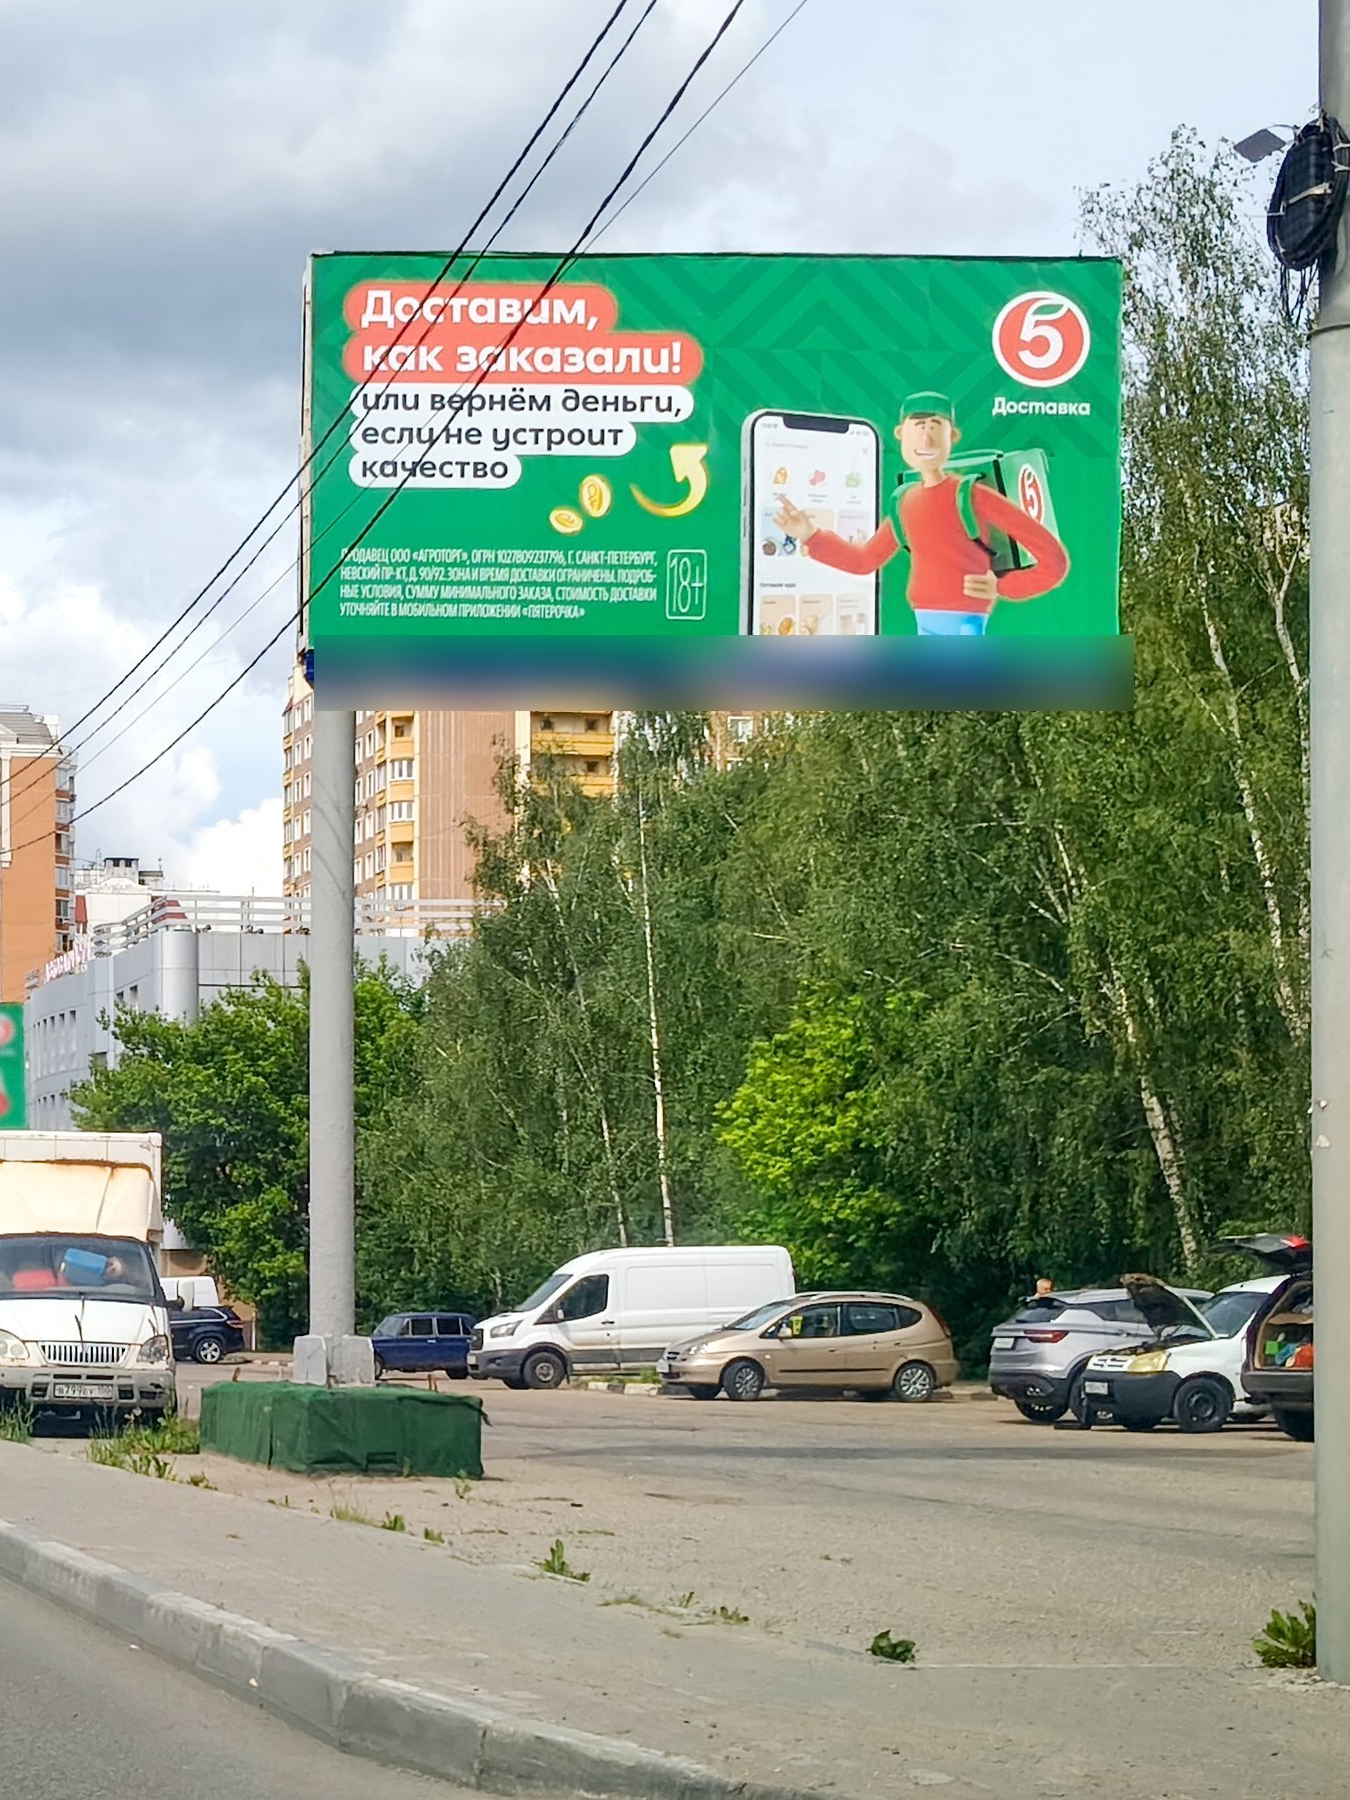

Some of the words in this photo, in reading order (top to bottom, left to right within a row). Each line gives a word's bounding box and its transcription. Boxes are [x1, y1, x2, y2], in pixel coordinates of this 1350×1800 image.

[361, 290, 599, 331] Доставим,
[1018, 299, 1065, 369] 5
[363, 345, 444, 372] как
[456, 341, 681, 374] заказали!
[362, 393, 419, 411] или
[431, 387, 551, 417] вернём
[561, 388, 681, 417] деньги,
[992, 396, 1091, 416] Доставка
[361, 426, 434, 445] если
[444, 427, 482, 445] не
[492, 427, 623, 451] устроит
[361, 460, 508, 479] качество
[340, 548, 390, 564] ПРОДАВЕЦ
[390, 548, 411, 563] ООО
[471, 549, 496, 563] ОГРН
[567, 550, 575, 565] Г.
[575, 550, 658, 567] САНКТ-ПЕТЕРБУРГ,
[340, 563, 381, 581] НЕВСКИЙ
[471, 567, 479, 581] И
[510, 567, 555, 584] ДОСТАВКИ
[669, 556, 704, 613] 18+
[339, 584, 359, 599] НЫЕ
[360, 584, 404, 601] УСЛОВИЯ,
[405, 584, 439, 600] СУММУ
[517, 586, 555, 603] ЗАКАЗА,
[555, 586, 609, 601] СТОИМОСТЬ
[609, 586, 657, 603] ДОСТАВКИ
[339, 599, 390, 616] УТОЧНЯЙТЕ
[390, 602, 398, 617] В
[398, 602, 458, 618] МОБИЛЬНОМ
